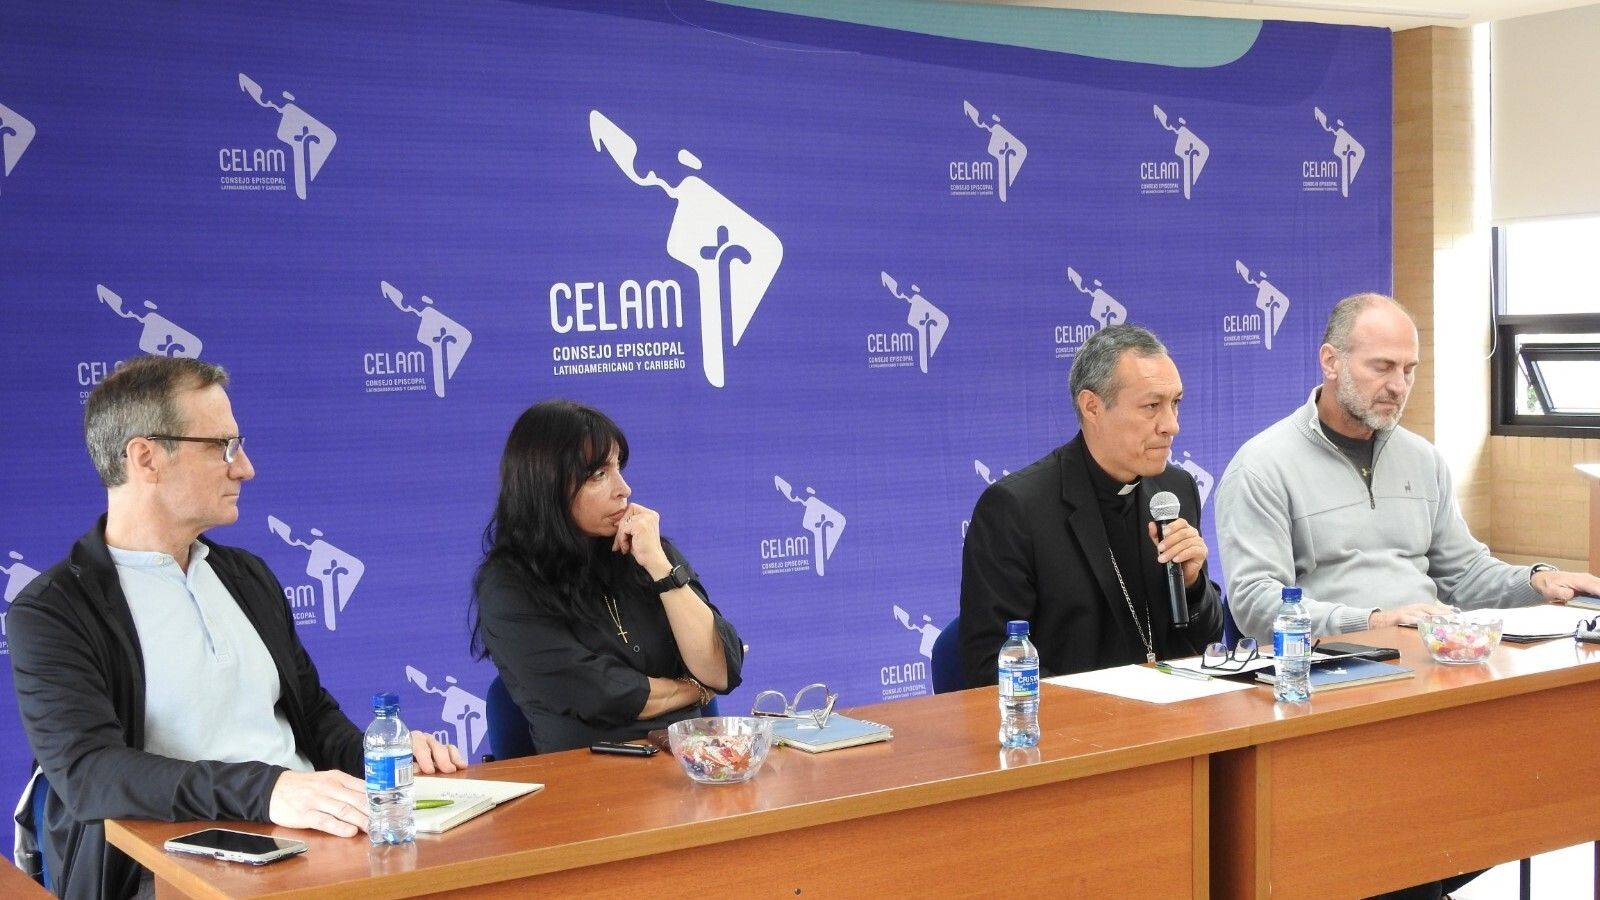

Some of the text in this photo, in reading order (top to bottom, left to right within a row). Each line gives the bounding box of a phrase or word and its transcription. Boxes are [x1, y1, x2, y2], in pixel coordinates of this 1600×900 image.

[219, 148, 286, 172] CELAM
[1302, 160, 1338, 178] CELAM
[950, 161, 993, 181] CELAM
[1140, 161, 1179, 180] CELAM
[549, 279, 683, 334] CELAM
[1224, 314, 1260, 332] CELAM
[553, 342, 685, 361] CONSEJO EPISCOPAL
[868, 332, 913, 353] CELAM
[78, 361, 124, 385] CEL
[364, 351, 426, 375] CELAM
[553, 358, 686, 376] LATINOAMERICANO Y CARIBEÑO
[761, 536, 809, 559] CELAM
[292, 612, 316, 620] SCOPAL
[881, 662, 926, 686] CELAM
